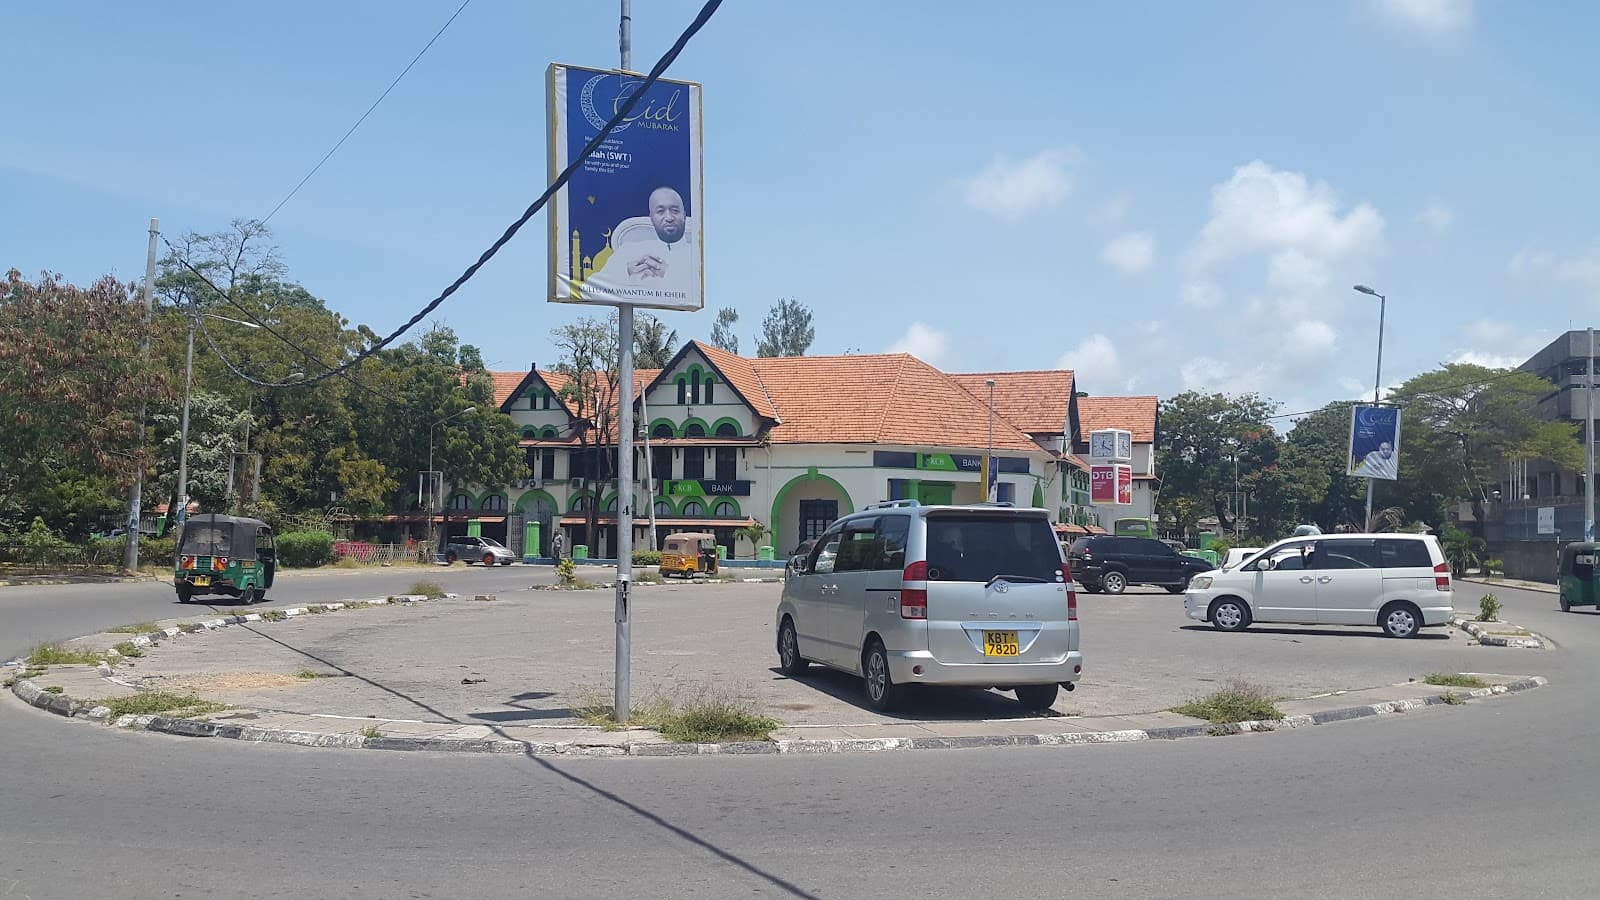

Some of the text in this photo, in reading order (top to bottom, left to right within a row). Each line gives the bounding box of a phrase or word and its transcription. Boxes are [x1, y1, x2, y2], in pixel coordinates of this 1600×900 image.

[612, 81, 682, 122] Eid
[637, 122, 679, 131] MUBARAK
[962, 458, 982, 467] BANK
[711, 484, 733, 492] BANK
[987, 632, 1008, 644] KBT
[988, 643, 1017, 655] 782D
